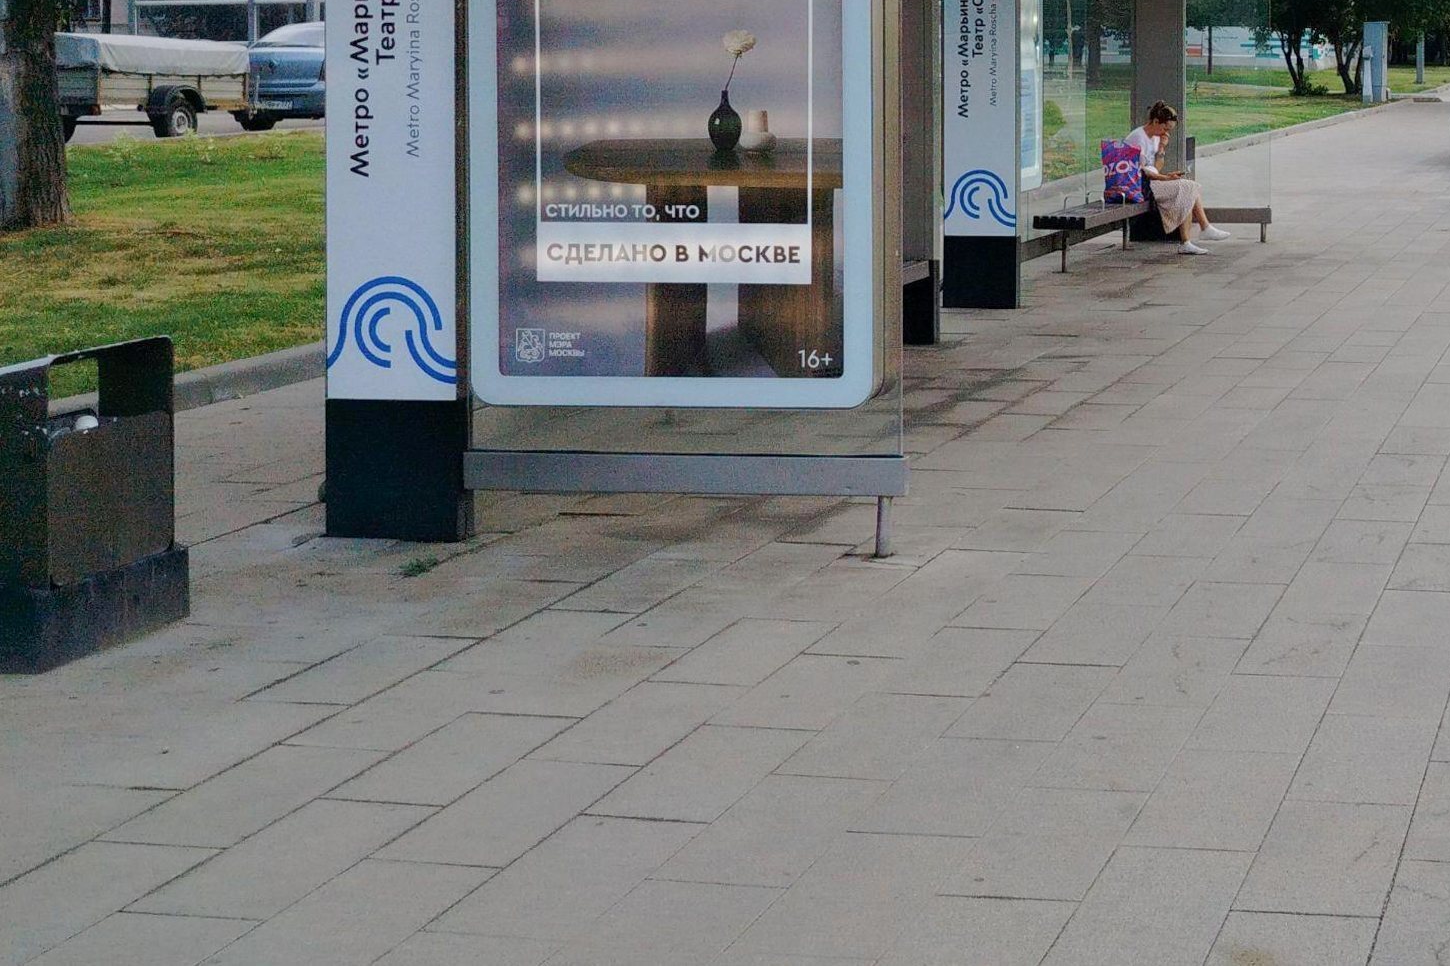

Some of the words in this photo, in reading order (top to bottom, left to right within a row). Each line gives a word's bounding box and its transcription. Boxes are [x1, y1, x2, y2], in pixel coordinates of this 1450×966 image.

[989, 3, 997, 35] Roscha
[972, 18, 986, 58] Театр
[406, 30, 423, 100] Maryina
[989, 38, 999, 75] Maryina
[957, 70, 971, 118] Метро
[989, 79, 997, 106] Metro
[349, 88, 374, 178] Метро
[406, 105, 420, 158] Metro
[546, 203, 628, 218] СТИЛЬНО
[633, 204, 660, 221] ТО,
[665, 204, 700, 219] ЧТО
[547, 243, 667, 264] СДЕЛАНО
[675, 244, 690, 263] В
[698, 244, 801, 264] МОСКВЕ
[548, 332, 581, 340] ПРОЕКТ
[548, 349, 585, 357] МОСКВЫ
[798, 349, 833, 368] 16+
